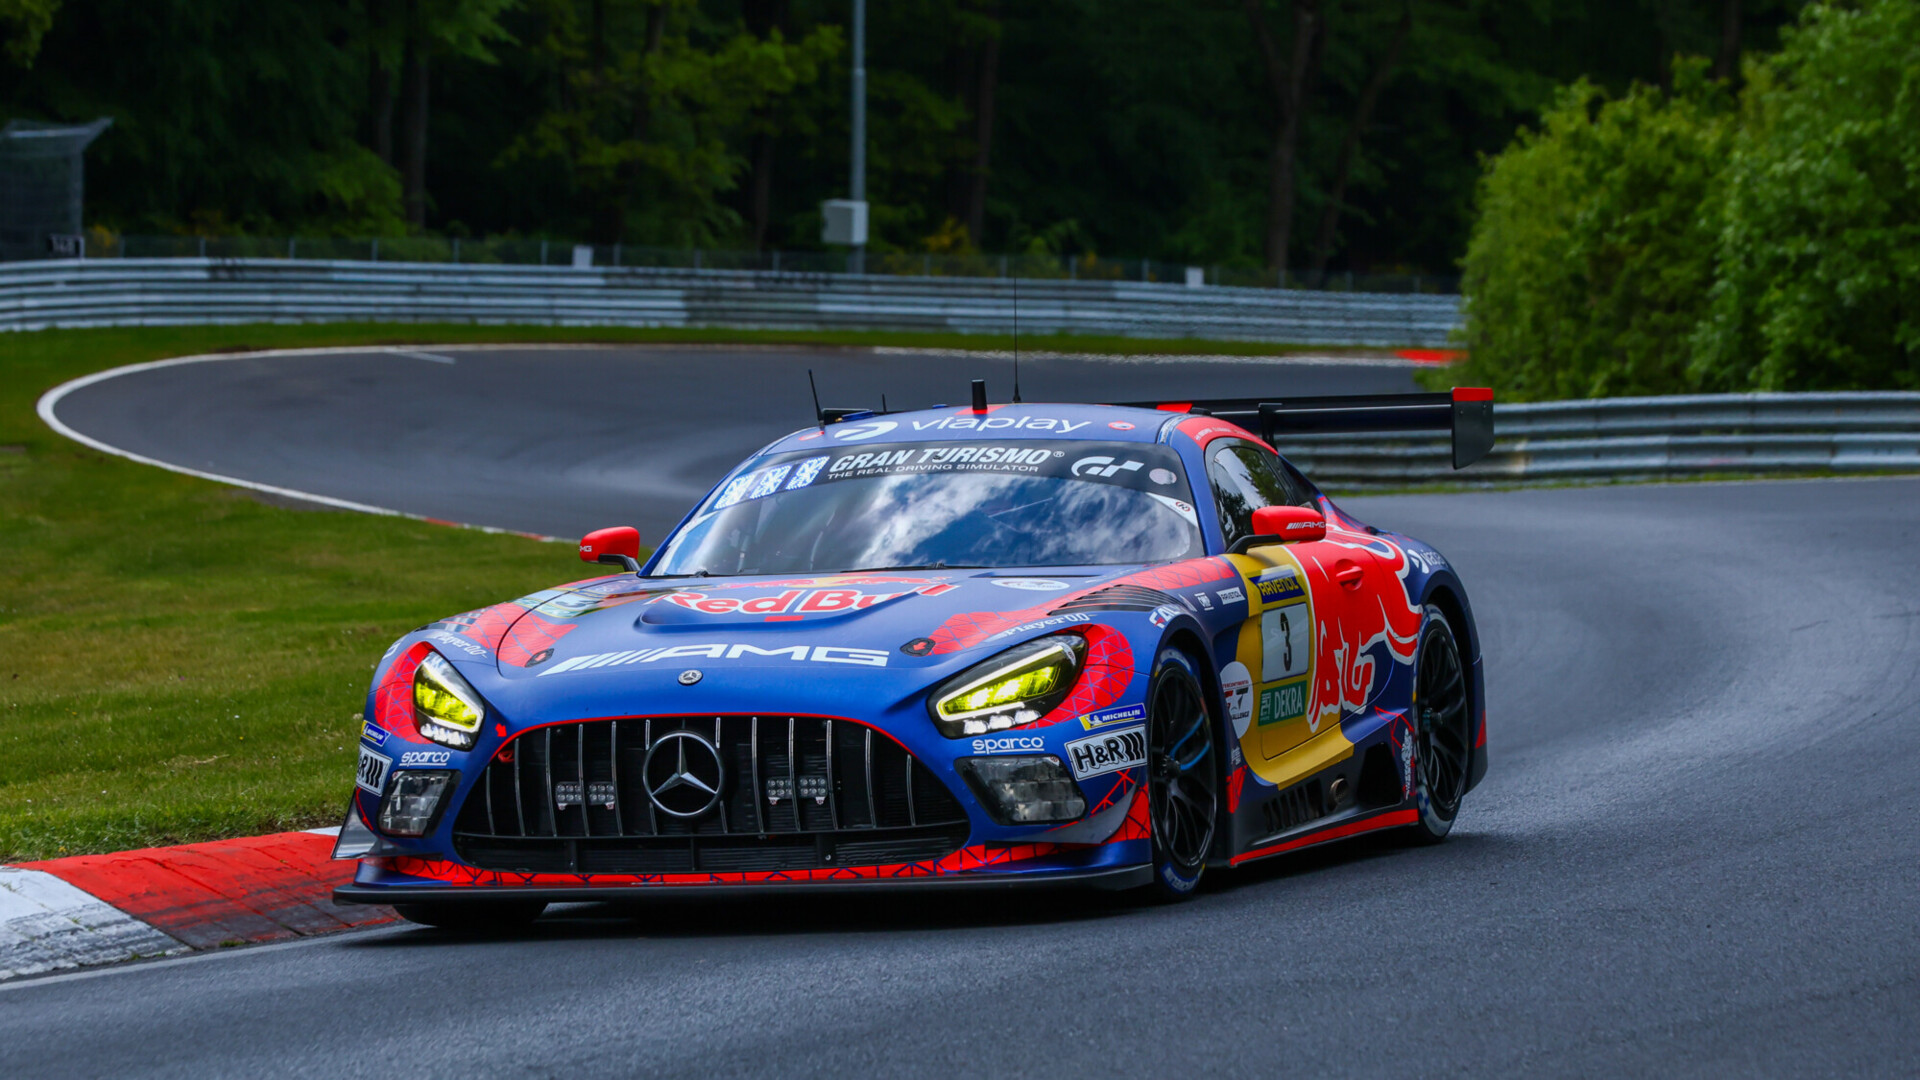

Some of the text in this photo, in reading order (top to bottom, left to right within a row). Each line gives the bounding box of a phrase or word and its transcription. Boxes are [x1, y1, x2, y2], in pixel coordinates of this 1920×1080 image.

[911, 415, 1092, 434] viaplay
[827, 463, 1039, 480] THE REAL DRIVING SIMULATOR
[829, 449, 916, 473] GRAN
[651, 588, 800, 614] Red
[1279, 611, 1293, 672] 3
[1274, 684, 1303, 720] DEKRA
[1101, 708, 1141, 722] MICHELIN
[971, 735, 1045, 755] sparco
[1073, 738, 1125, 772] H&R
[401, 750, 451, 767] sparco
